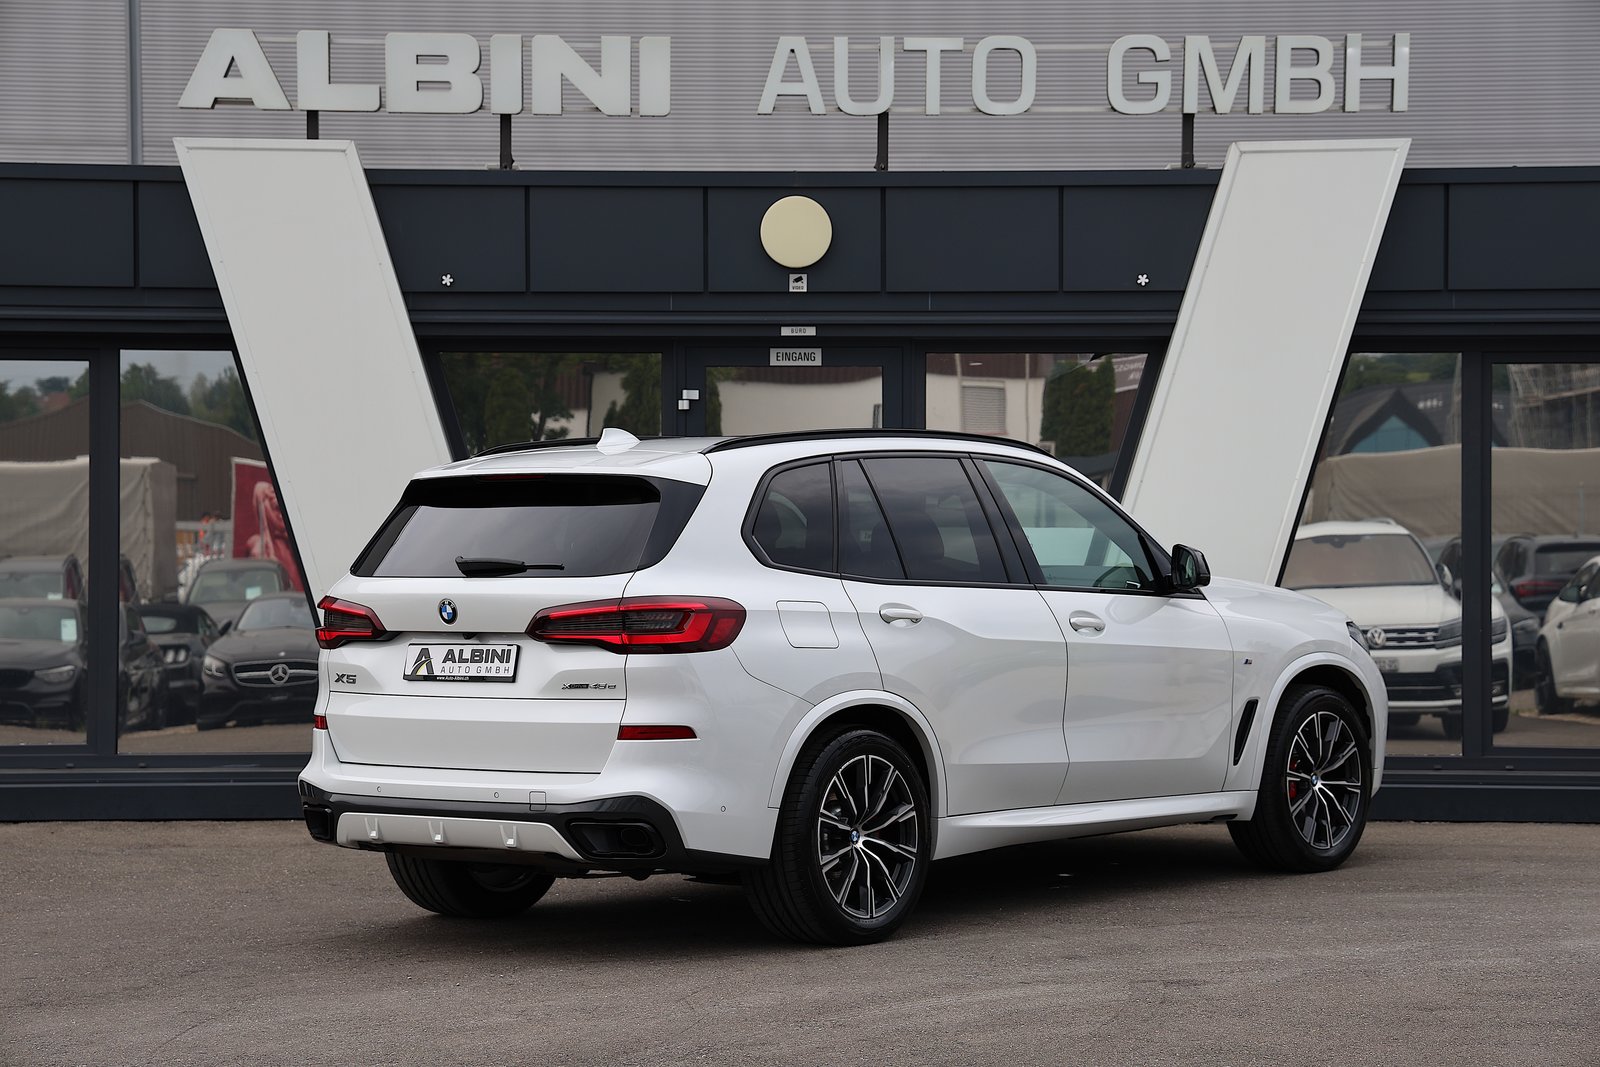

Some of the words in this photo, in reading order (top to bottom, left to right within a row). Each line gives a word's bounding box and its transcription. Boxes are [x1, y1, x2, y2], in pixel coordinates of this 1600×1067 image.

[178, 27, 671, 117] ALBINI
[756, 34, 1038, 116] AUTO
[1106, 32, 1410, 115] GMBH
[776, 352, 816, 362] EINGANG
[442, 648, 512, 664] ALBINI
[440, 666, 471, 674] AUTO
[476, 666, 510, 674] GMBH
[334, 672, 357, 684] X5
